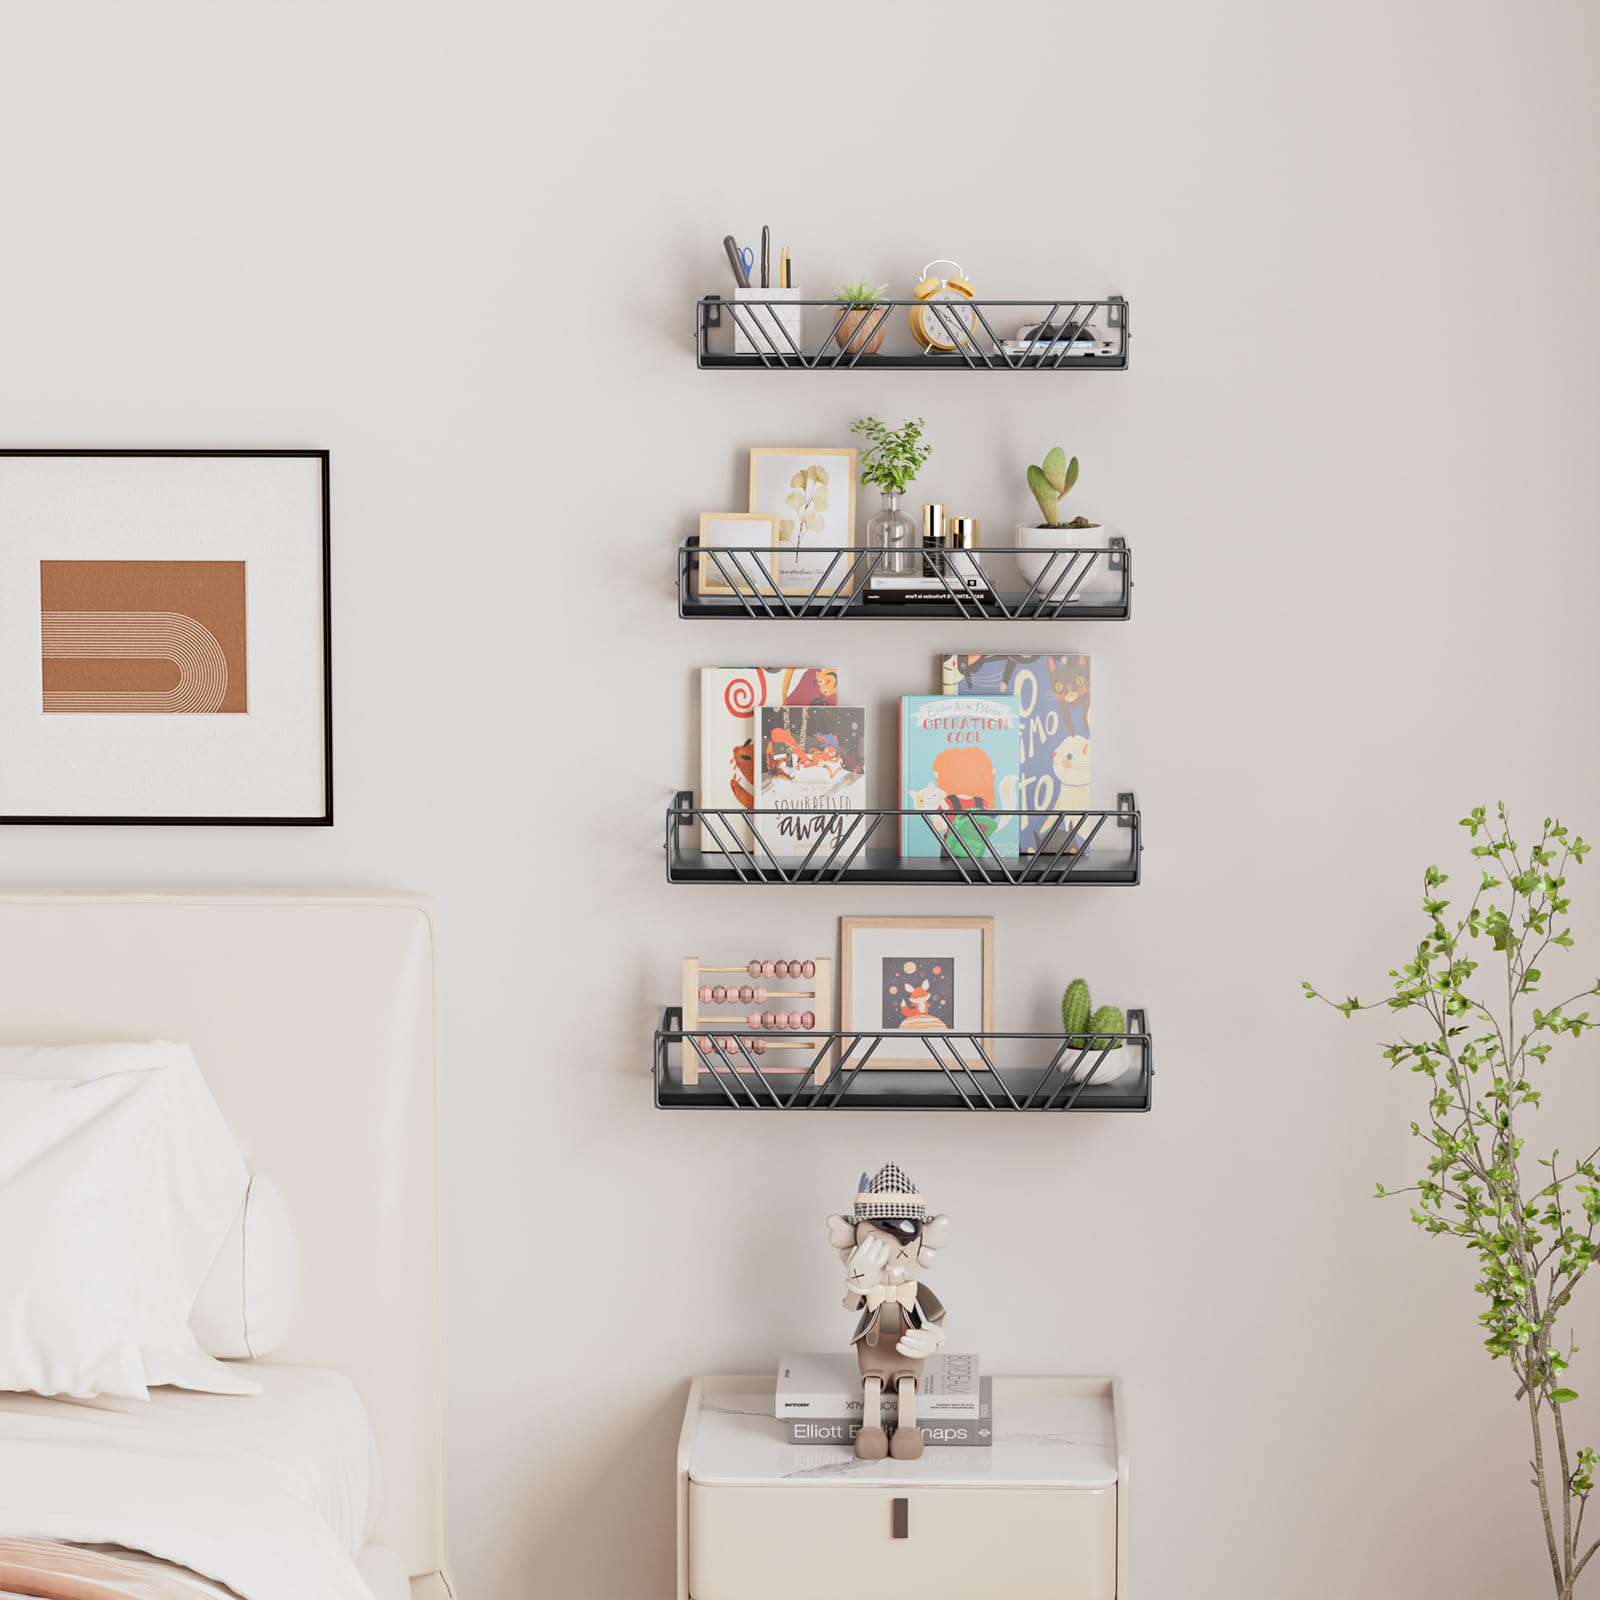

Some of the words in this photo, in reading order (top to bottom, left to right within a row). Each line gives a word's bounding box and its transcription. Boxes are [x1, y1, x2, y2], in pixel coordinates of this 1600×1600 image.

[922, 717, 1009, 730] OPERATION
[946, 731, 984, 743] COOL
[777, 815, 845, 849] away
[794, 1424, 843, 1438] Elliott
[918, 1426, 968, 1442] naps
